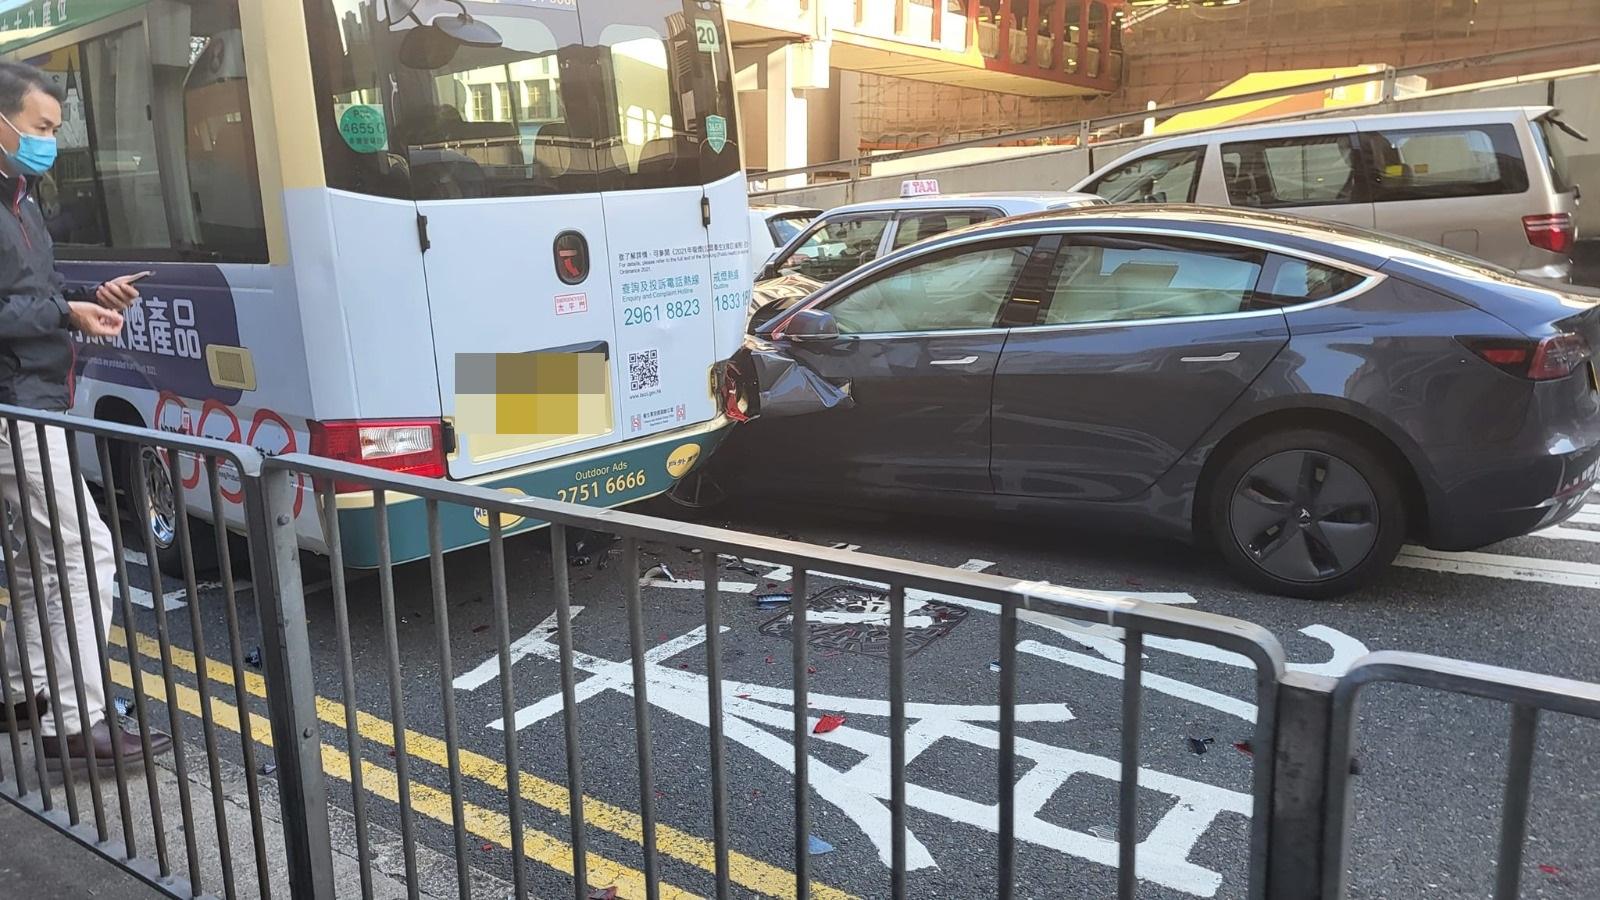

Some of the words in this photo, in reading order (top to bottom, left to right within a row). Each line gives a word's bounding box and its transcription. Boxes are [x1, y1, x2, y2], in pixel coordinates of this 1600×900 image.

[697, 26, 715, 45] 20
[912, 181, 937, 193] TAXI
[623, 292, 641, 302] Enquiry
[642, 291, 652, 299] and
[653, 289, 677, 299] Complaint
[714, 292, 740, 312] 1833
[624, 304, 660, 326] 2961
[666, 298, 700, 320] 8823
[575, 465, 610, 481] Outdoor
[611, 461, 628, 473] Ads
[557, 482, 599, 505] 2751
[605, 469, 646, 494] 6666
